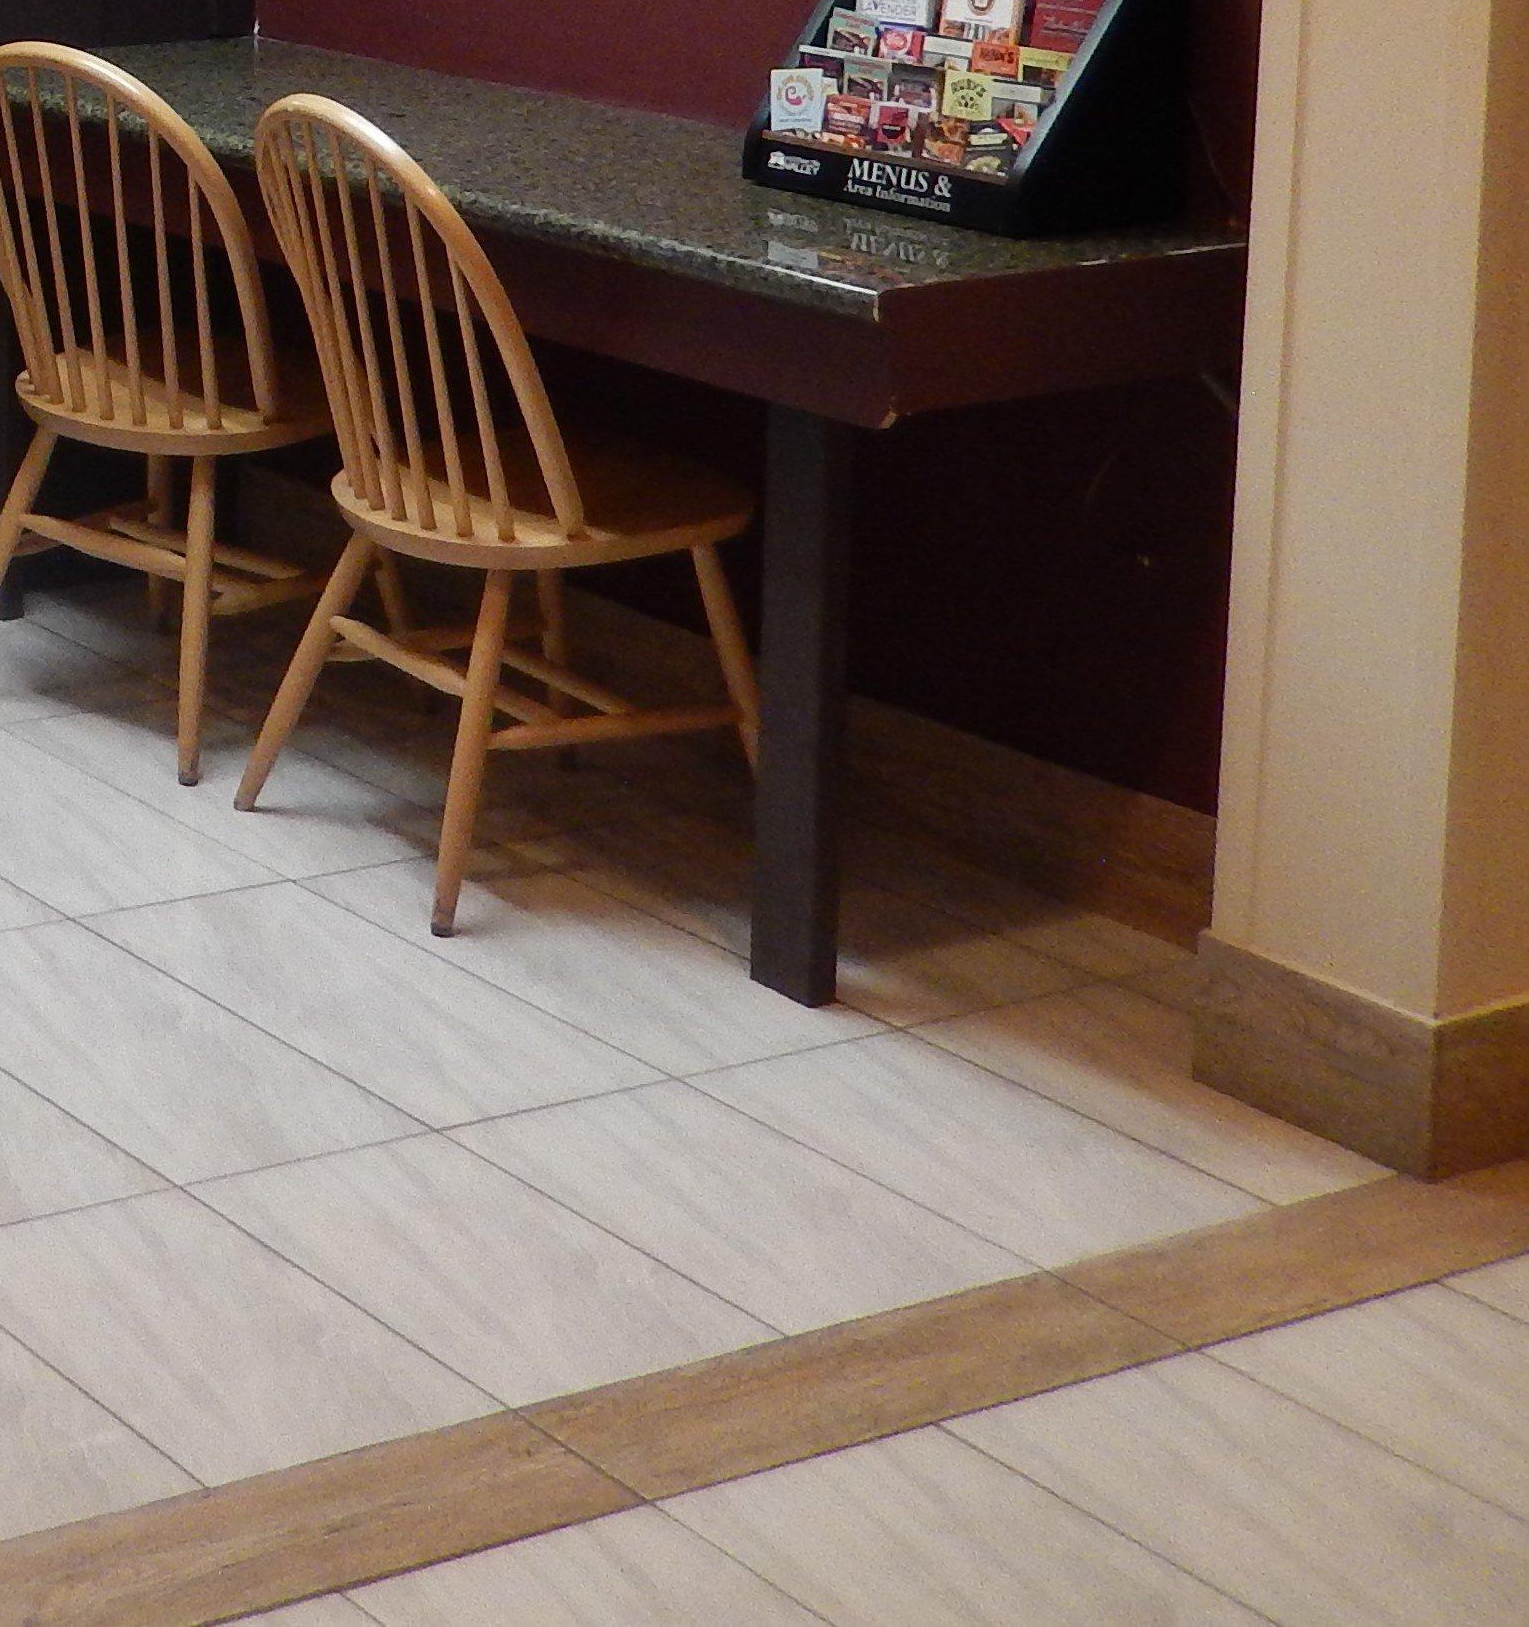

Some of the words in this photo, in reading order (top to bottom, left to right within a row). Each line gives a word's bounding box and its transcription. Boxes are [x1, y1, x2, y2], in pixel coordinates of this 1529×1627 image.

[848, 158, 930, 194] MENUS
[933, 174, 953, 198] &
[843, 180, 873, 197] Area
[875, 185, 951, 213] Information
